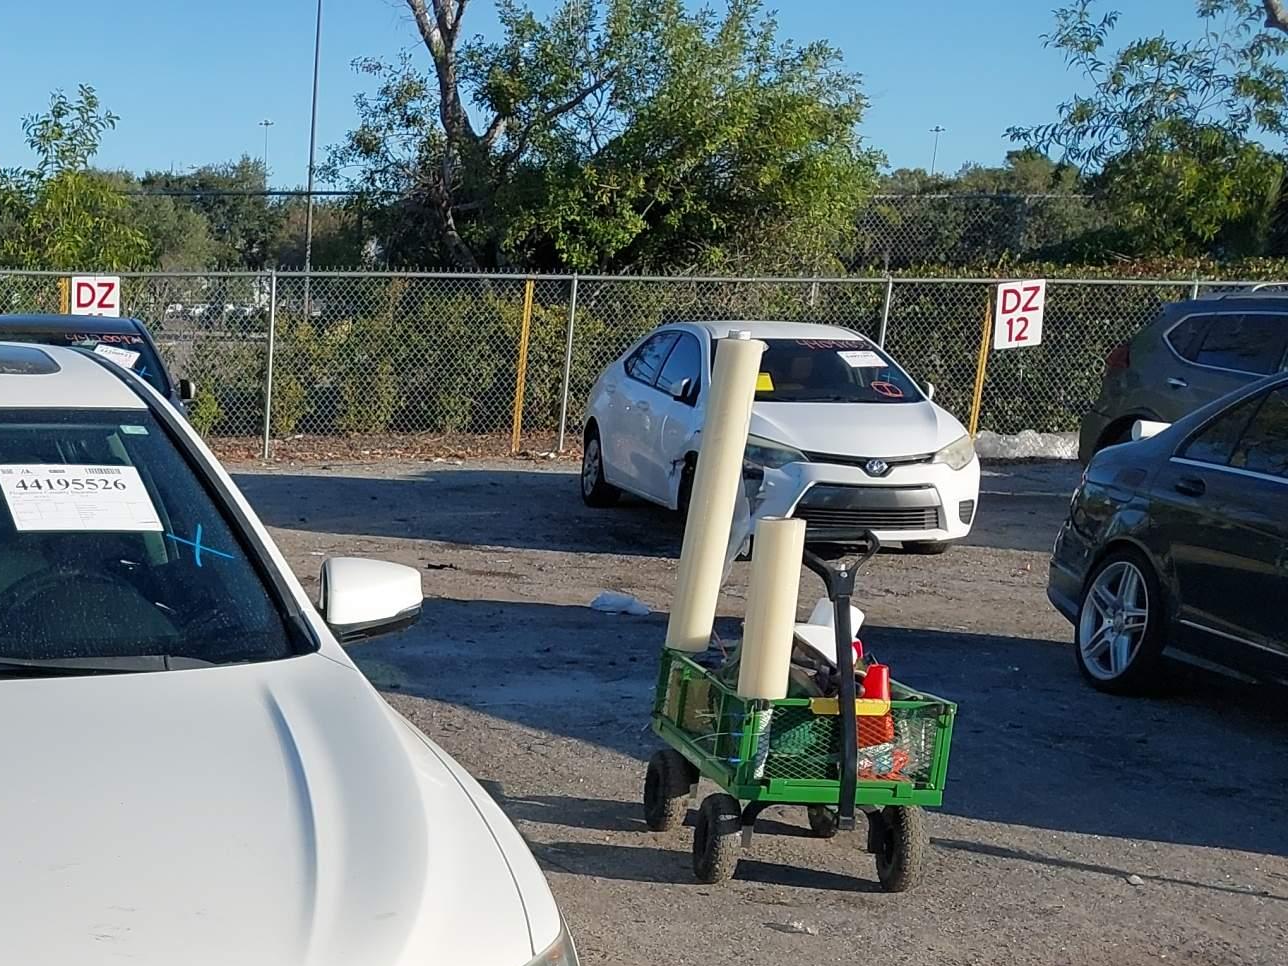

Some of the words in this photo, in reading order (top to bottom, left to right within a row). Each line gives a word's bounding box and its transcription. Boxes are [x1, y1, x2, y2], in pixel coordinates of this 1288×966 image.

[76, 282, 116, 309] DZ
[1001, 286, 1041, 315] DZ
[1006, 316, 1029, 342] 12
[15, 478, 127, 491] 44195526
